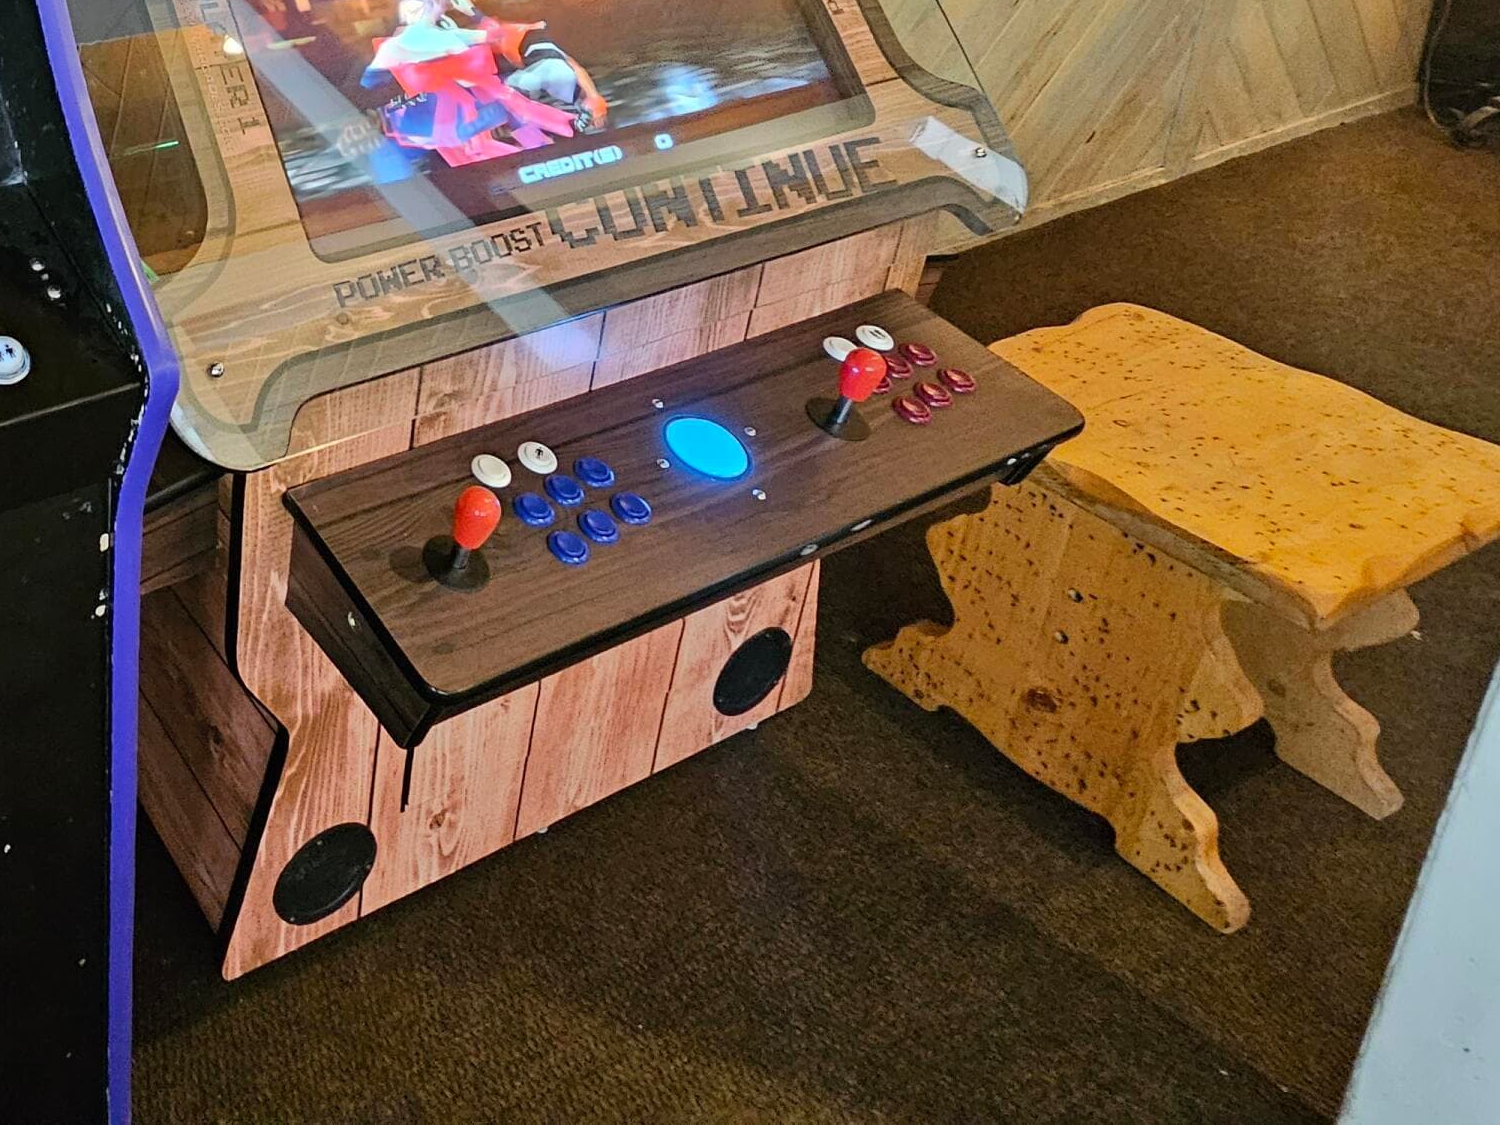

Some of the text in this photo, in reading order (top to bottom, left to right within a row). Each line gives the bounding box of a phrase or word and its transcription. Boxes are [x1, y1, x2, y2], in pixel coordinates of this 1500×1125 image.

[654, 133, 674, 150] 0
[332, 136, 898, 308] POWER BOOST CONTINUE
